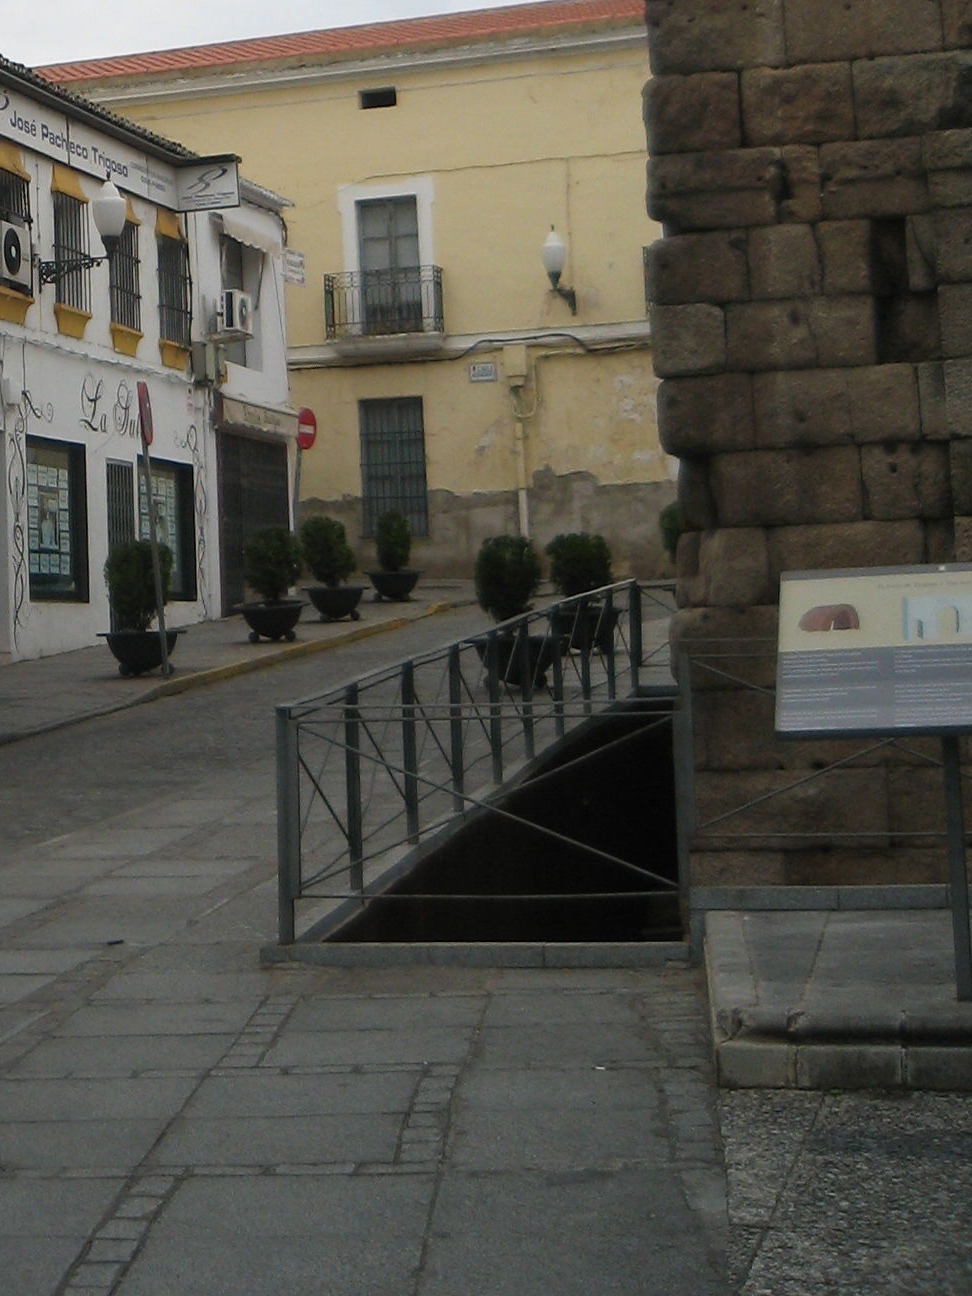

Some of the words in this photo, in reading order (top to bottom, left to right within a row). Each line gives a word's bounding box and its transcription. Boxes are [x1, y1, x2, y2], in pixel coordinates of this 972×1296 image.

[10, 110, 37, 137] José
[40, 123, 89, 160] Pacheco
[90, 146, 129, 178] Trigoso
